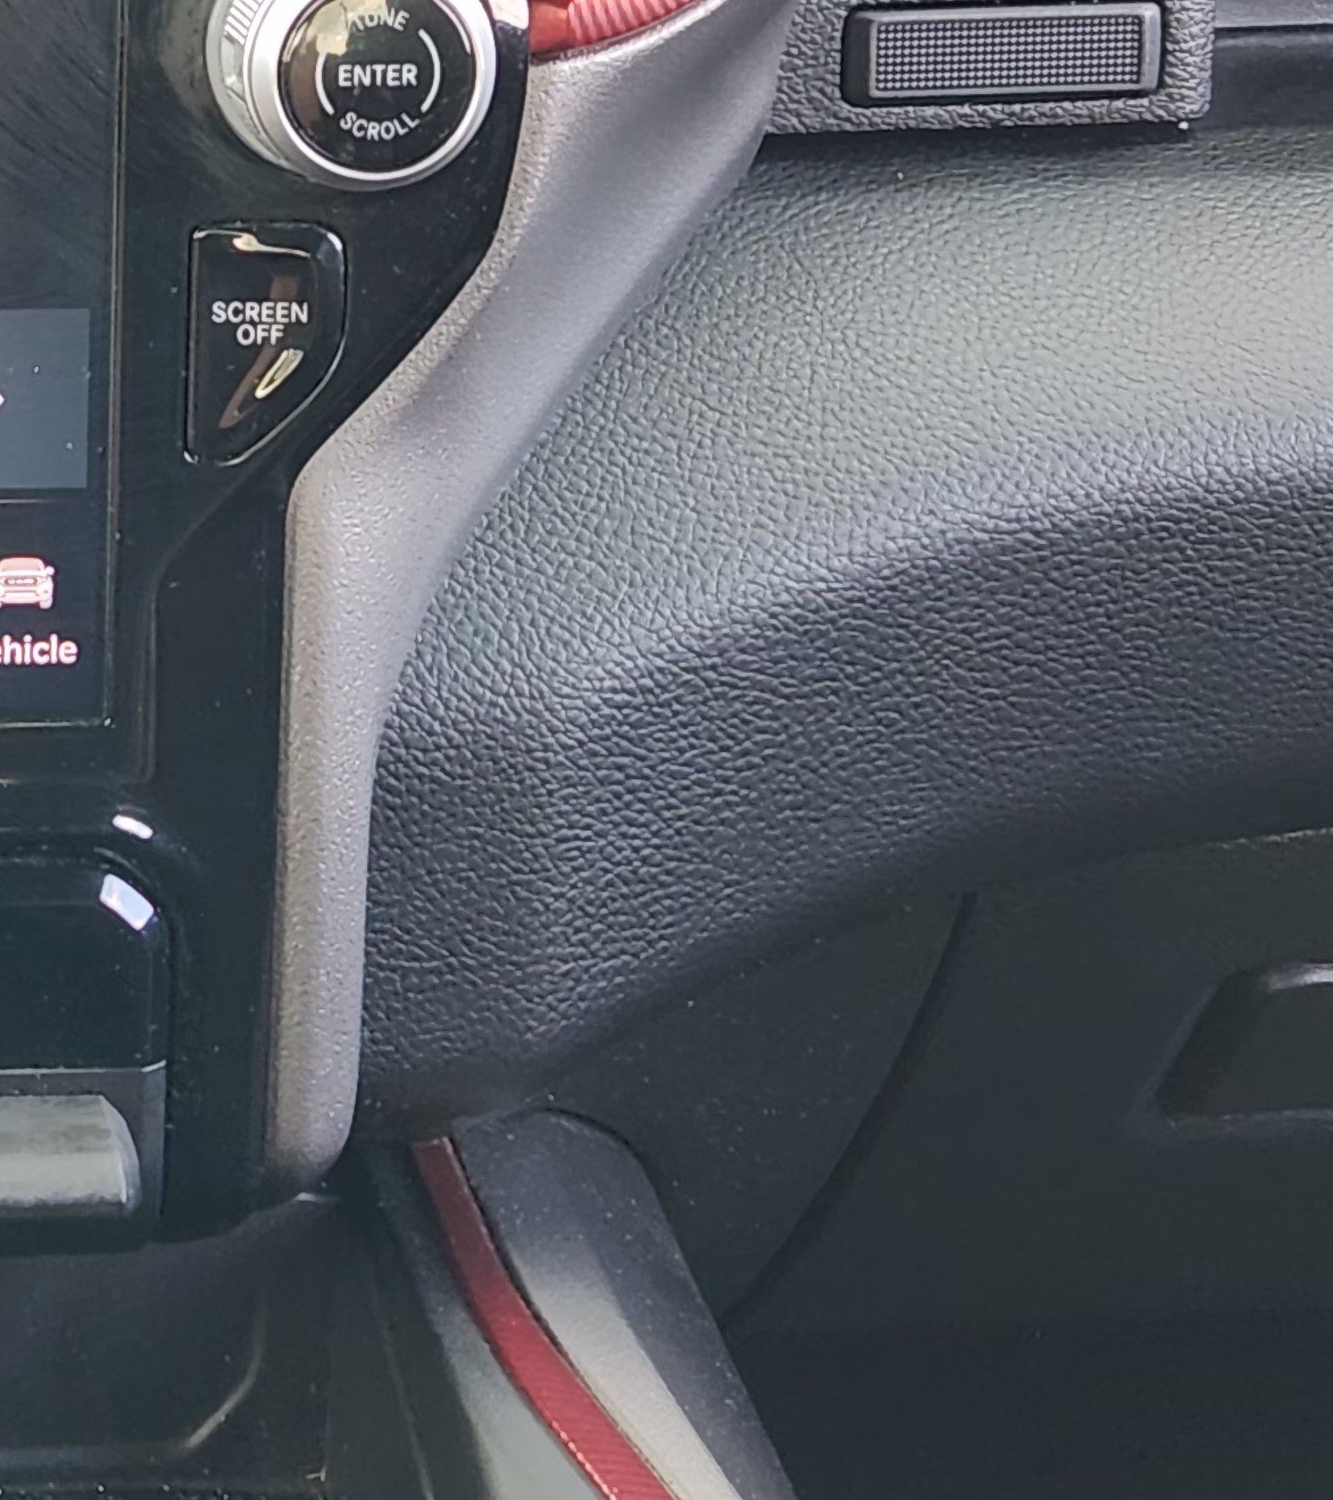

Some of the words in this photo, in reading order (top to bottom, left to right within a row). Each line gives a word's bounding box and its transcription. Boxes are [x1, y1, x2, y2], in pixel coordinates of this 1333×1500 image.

[338, 64, 417, 87] ENTER
[339, 111, 420, 141] SCROLL
[211, 301, 309, 324] SCREEN
[236, 324, 285, 346] OFF
